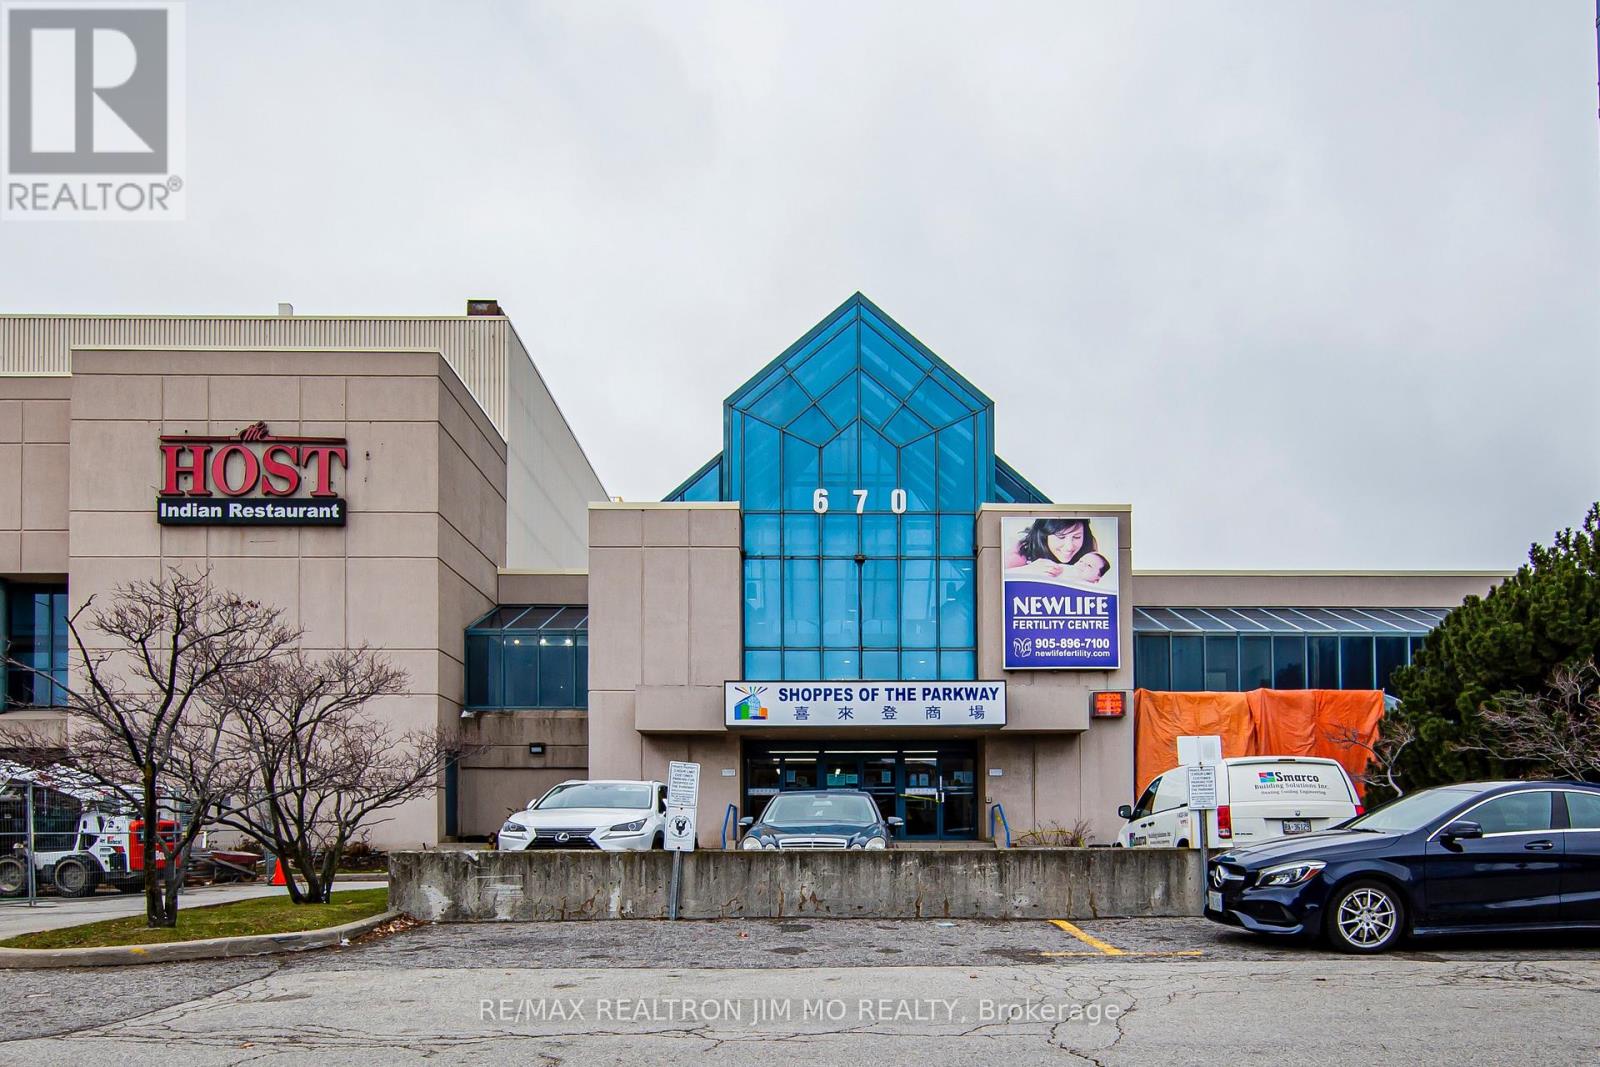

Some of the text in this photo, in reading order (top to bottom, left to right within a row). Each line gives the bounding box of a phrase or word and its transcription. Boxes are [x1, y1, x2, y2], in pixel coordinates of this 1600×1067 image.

[159, 444, 348, 497] HOST
[160, 503, 339, 518] Indian Restaurant
[1013, 596, 1109, 615] NEWLIFE
[1013, 620, 1109, 630] FERTILITY CENTRE
[1035, 638, 1110, 649] 905-896-7100
[1035, 650, 1110, 658] newlifefertility.com
[778, 687, 999, 702] SHOPPES OF THE PARKWAY
[1274, 771, 1320, 783] Smarco
